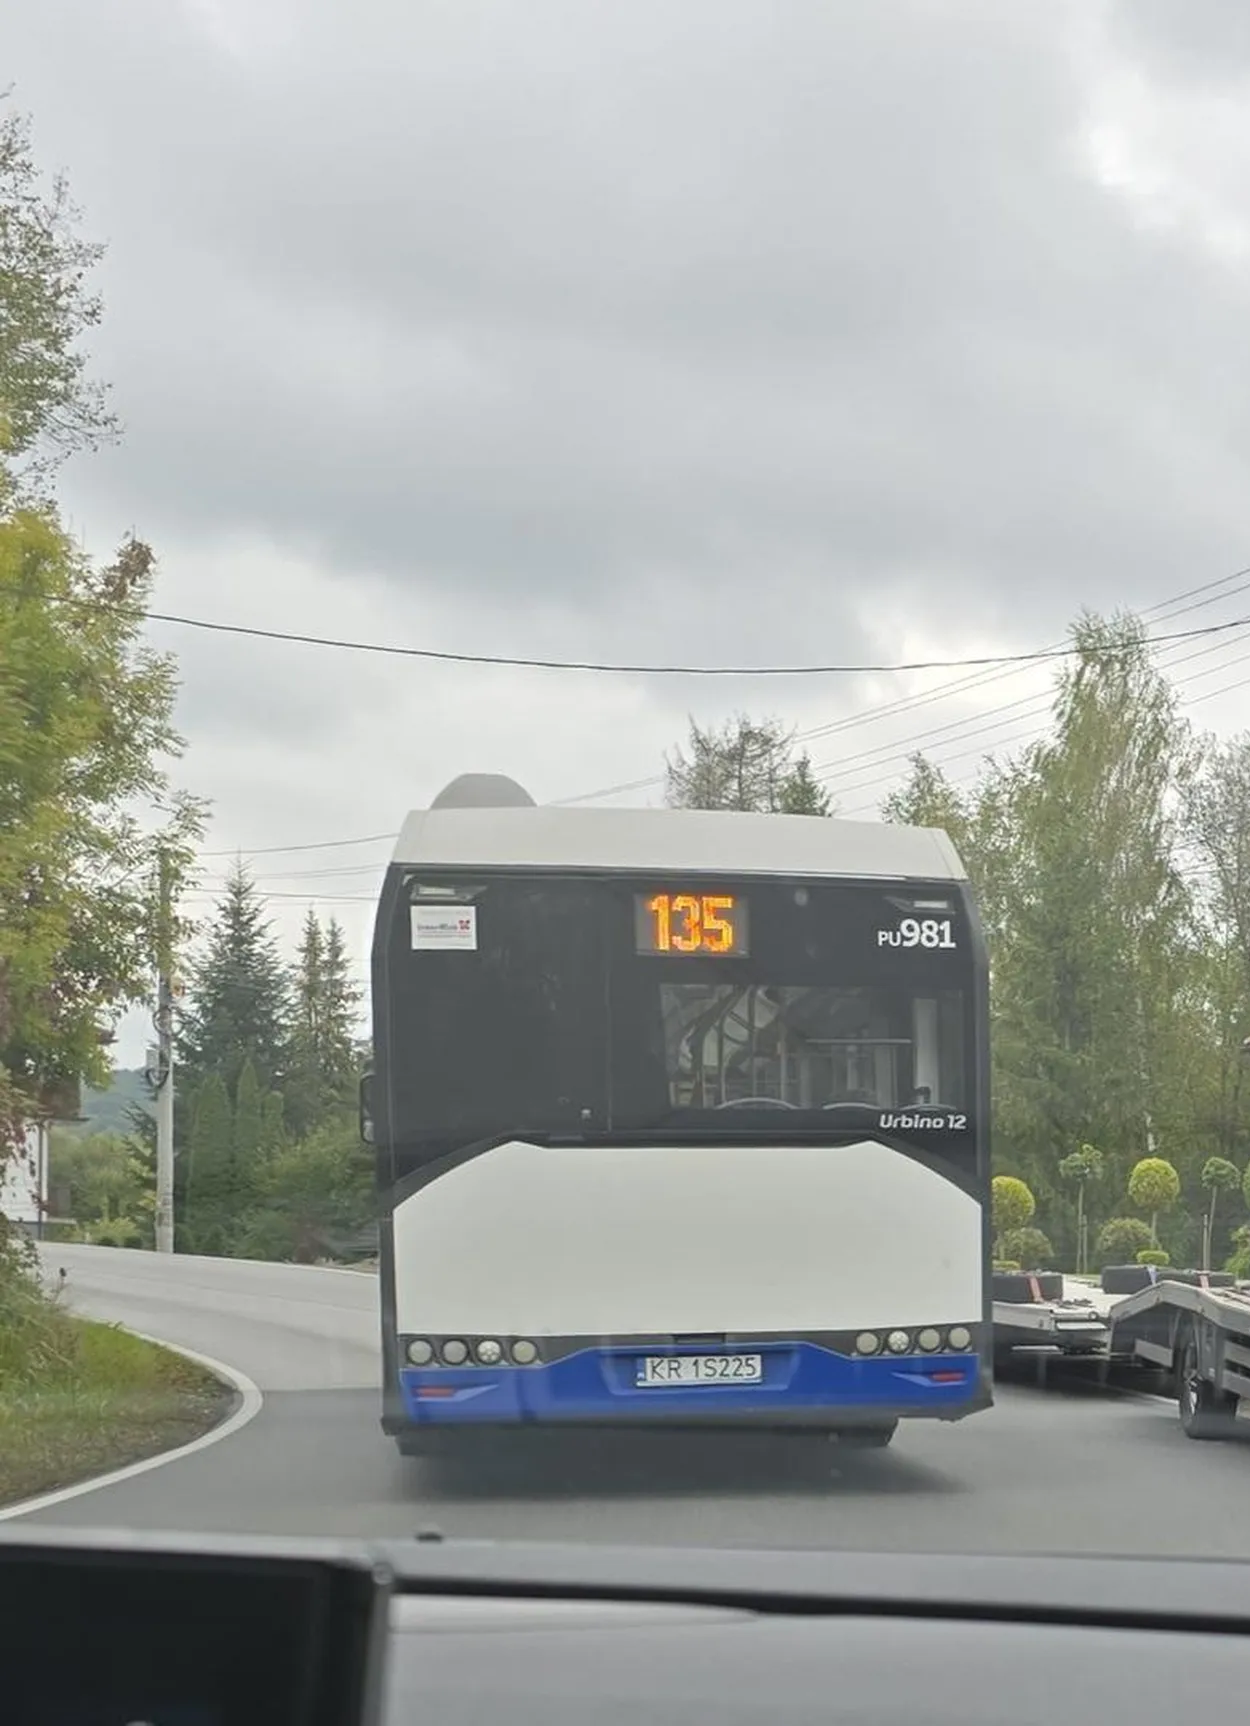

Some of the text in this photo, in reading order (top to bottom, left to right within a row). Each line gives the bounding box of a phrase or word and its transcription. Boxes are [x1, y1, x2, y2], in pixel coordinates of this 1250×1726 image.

[651, 895, 733, 951] 135
[880, 1114, 967, 1130] Urbino 12
[650, 1356, 757, 1380] KR 1S225
